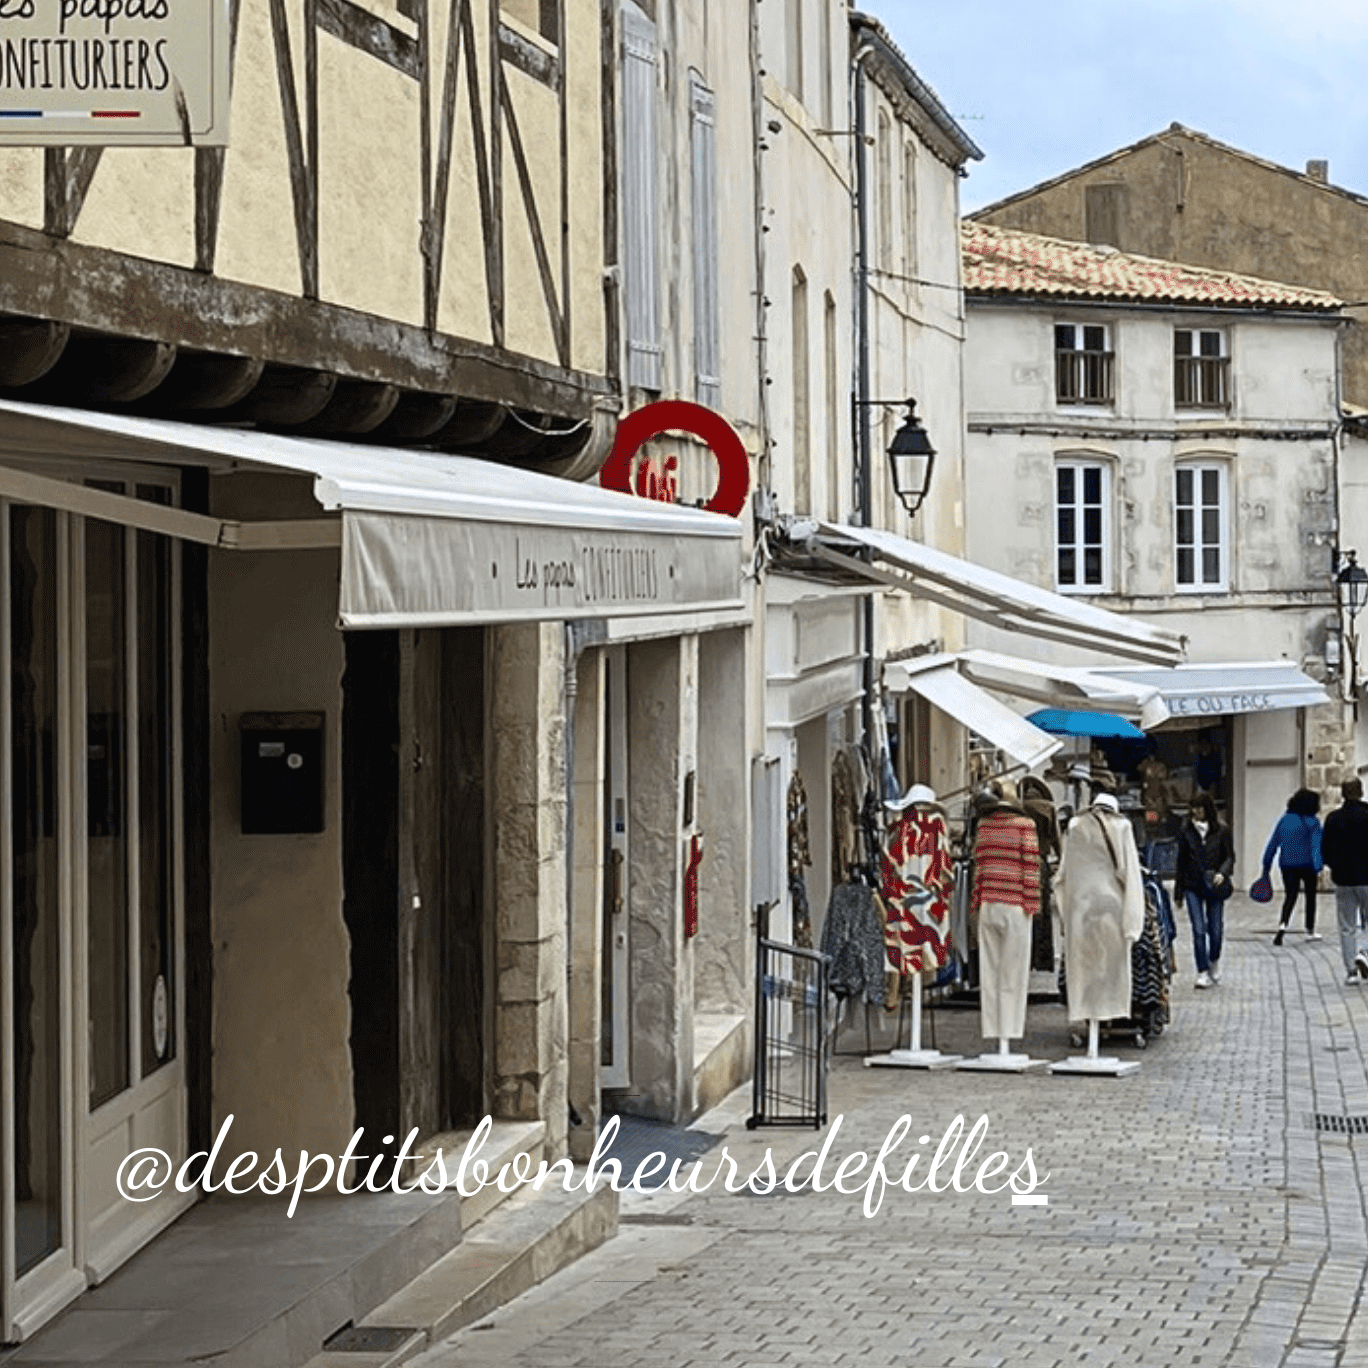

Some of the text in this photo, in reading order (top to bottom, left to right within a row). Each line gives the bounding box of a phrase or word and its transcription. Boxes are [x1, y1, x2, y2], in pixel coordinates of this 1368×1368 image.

[0, 38, 169, 91] NFITURIERS
[1163, 696, 1190, 714] LE
[1197, 696, 1223, 713] OU
